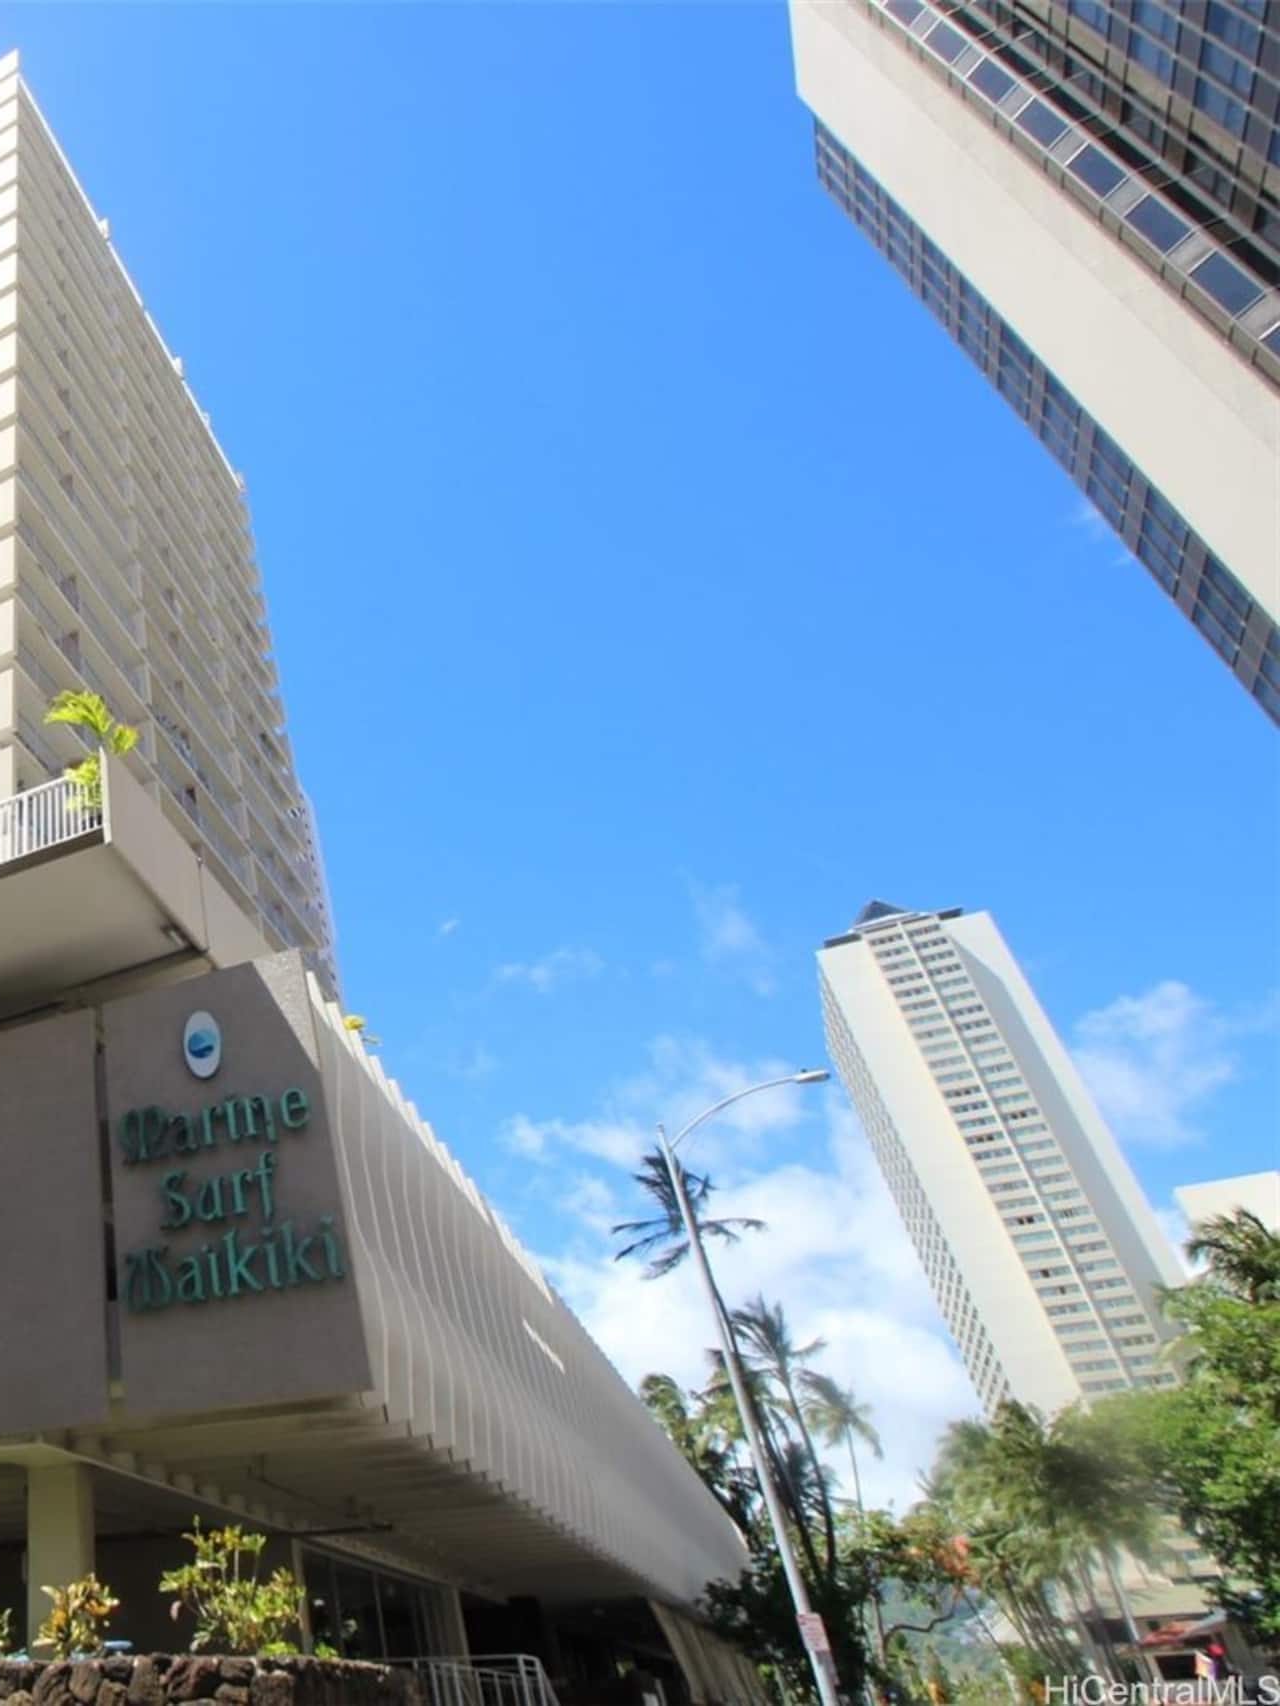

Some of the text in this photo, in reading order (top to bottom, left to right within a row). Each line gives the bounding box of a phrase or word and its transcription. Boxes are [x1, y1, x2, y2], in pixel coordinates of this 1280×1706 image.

[117, 1086, 311, 1166] Marine
[160, 1151, 276, 1231] Surf
[122, 1214, 347, 1314] Waikiki
